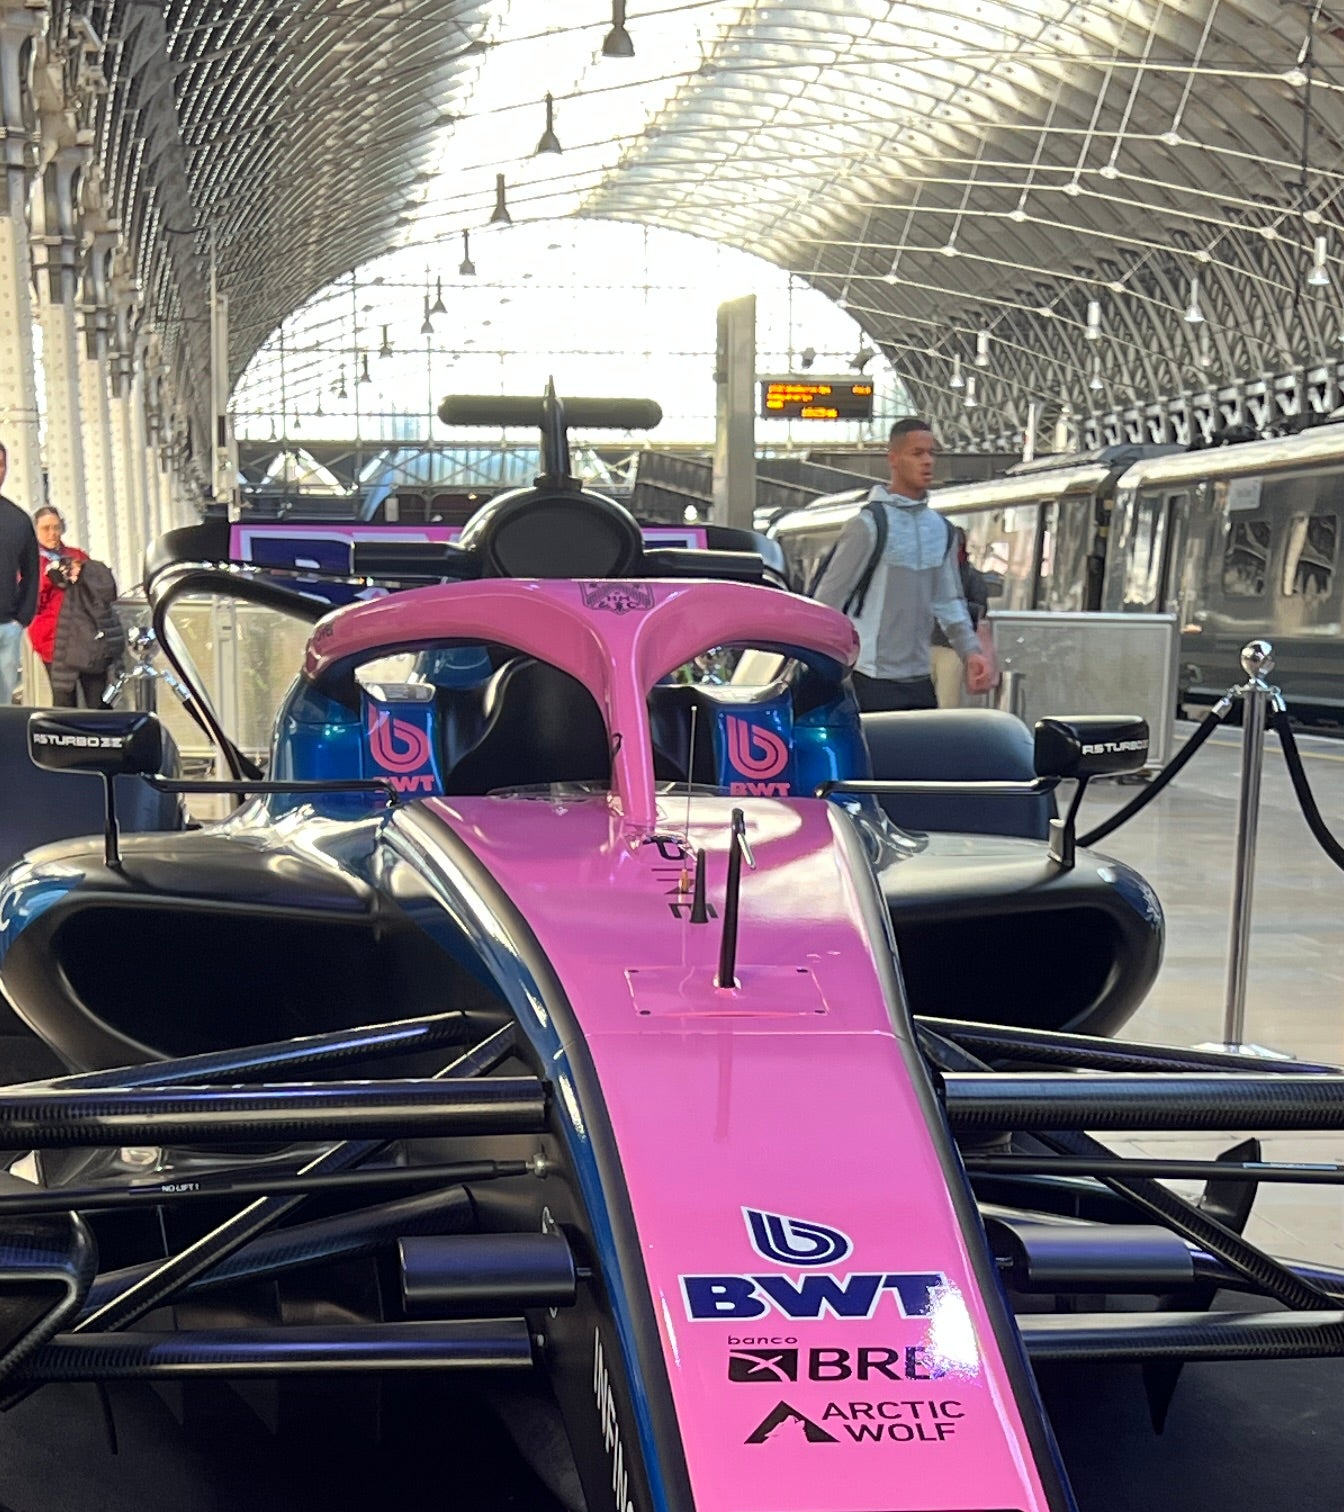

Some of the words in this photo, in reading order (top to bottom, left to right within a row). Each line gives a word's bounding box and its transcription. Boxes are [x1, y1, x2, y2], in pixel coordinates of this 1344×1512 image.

[373, 774, 434, 792] WT
[730, 782, 791, 797] BWT
[678, 1271, 948, 1322] BWT
[727, 1334, 798, 1345] banco
[821, 1400, 966, 1421] ARCTIC
[842, 1423, 957, 1443] WOLF
